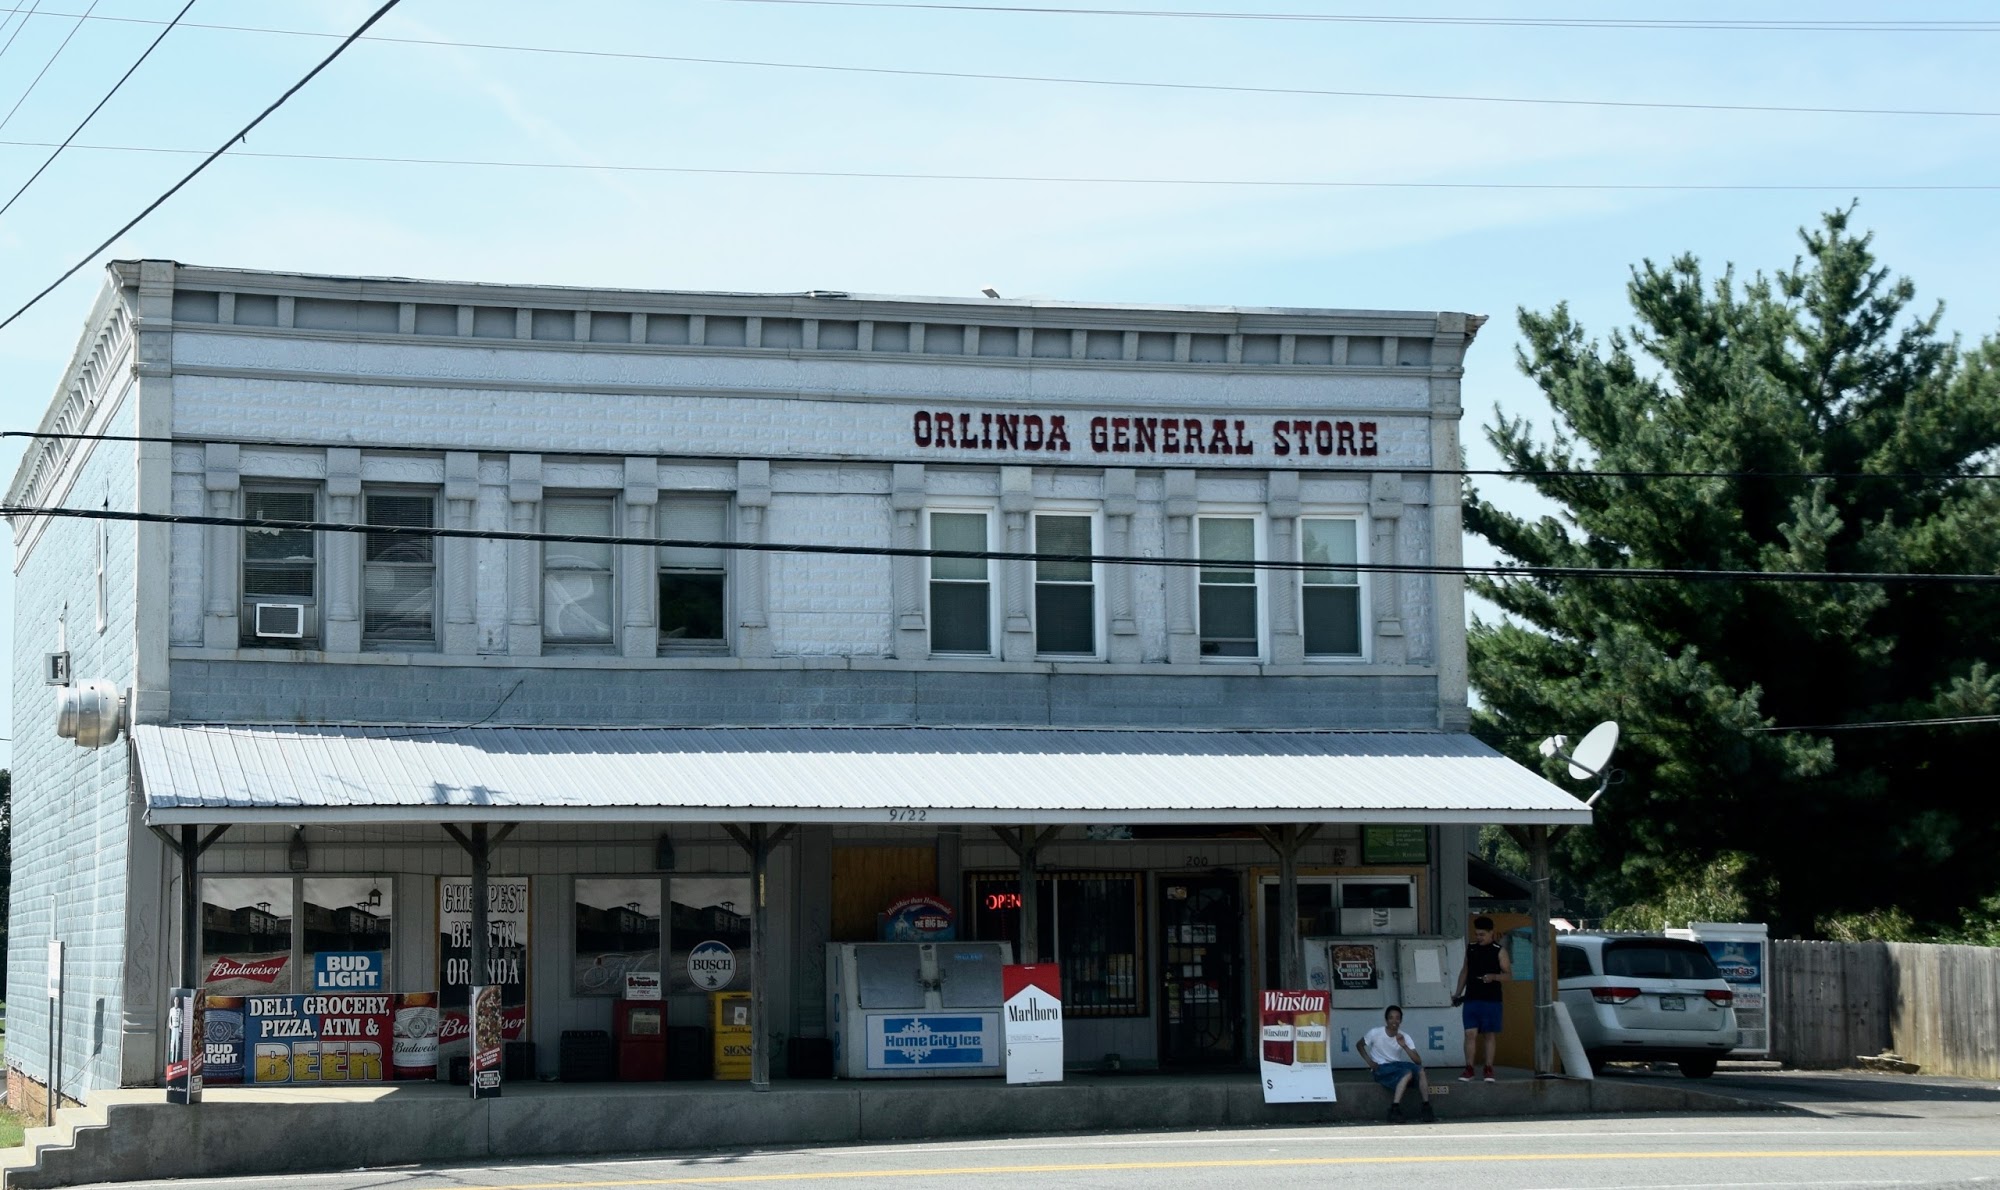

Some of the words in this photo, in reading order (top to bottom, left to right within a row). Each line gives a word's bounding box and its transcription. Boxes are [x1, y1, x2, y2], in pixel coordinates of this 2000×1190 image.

[913, 410, 1071, 451] ORLINDA
[1090, 416, 1253, 456] GENERAL
[1274, 419, 1378, 457] STORE
[1186, 856, 1207, 867] 200
[442, 884, 526, 913] CHEPEST
[985, 893, 1022, 910] OPEN
[451, 921, 494, 948] BER
[498, 920, 516, 948] IN
[209, 960, 280, 977] Budweiser
[327, 956, 370, 970] BUD
[447, 957, 520, 985] ORNDA
[692, 959, 731, 970] BUSCH
[318, 971, 378, 987] LIGHT
[250, 999, 297, 1018] DELI,
[302, 996, 390, 1017] GROCERY,
[1009, 997, 1058, 1022] Marlboro
[1264, 992, 1324, 1012] Winston
[261, 1020, 317, 1038] PIZZA,
[322, 1018, 364, 1036] ATM
[366, 1018, 379, 1036] &
[1264, 1029, 1289, 1037] Winston
[1297, 1029, 1321, 1038] Winston
[206, 1044, 233, 1053] BUD
[885, 1035, 927, 1046] Home
[929, 1035, 957, 1048] City
[959, 1034, 980, 1045] Ice
[203, 1053, 238, 1064] LIGHT
[255, 1041, 382, 1082] BEER
[1267, 1079, 1273, 1089] $
